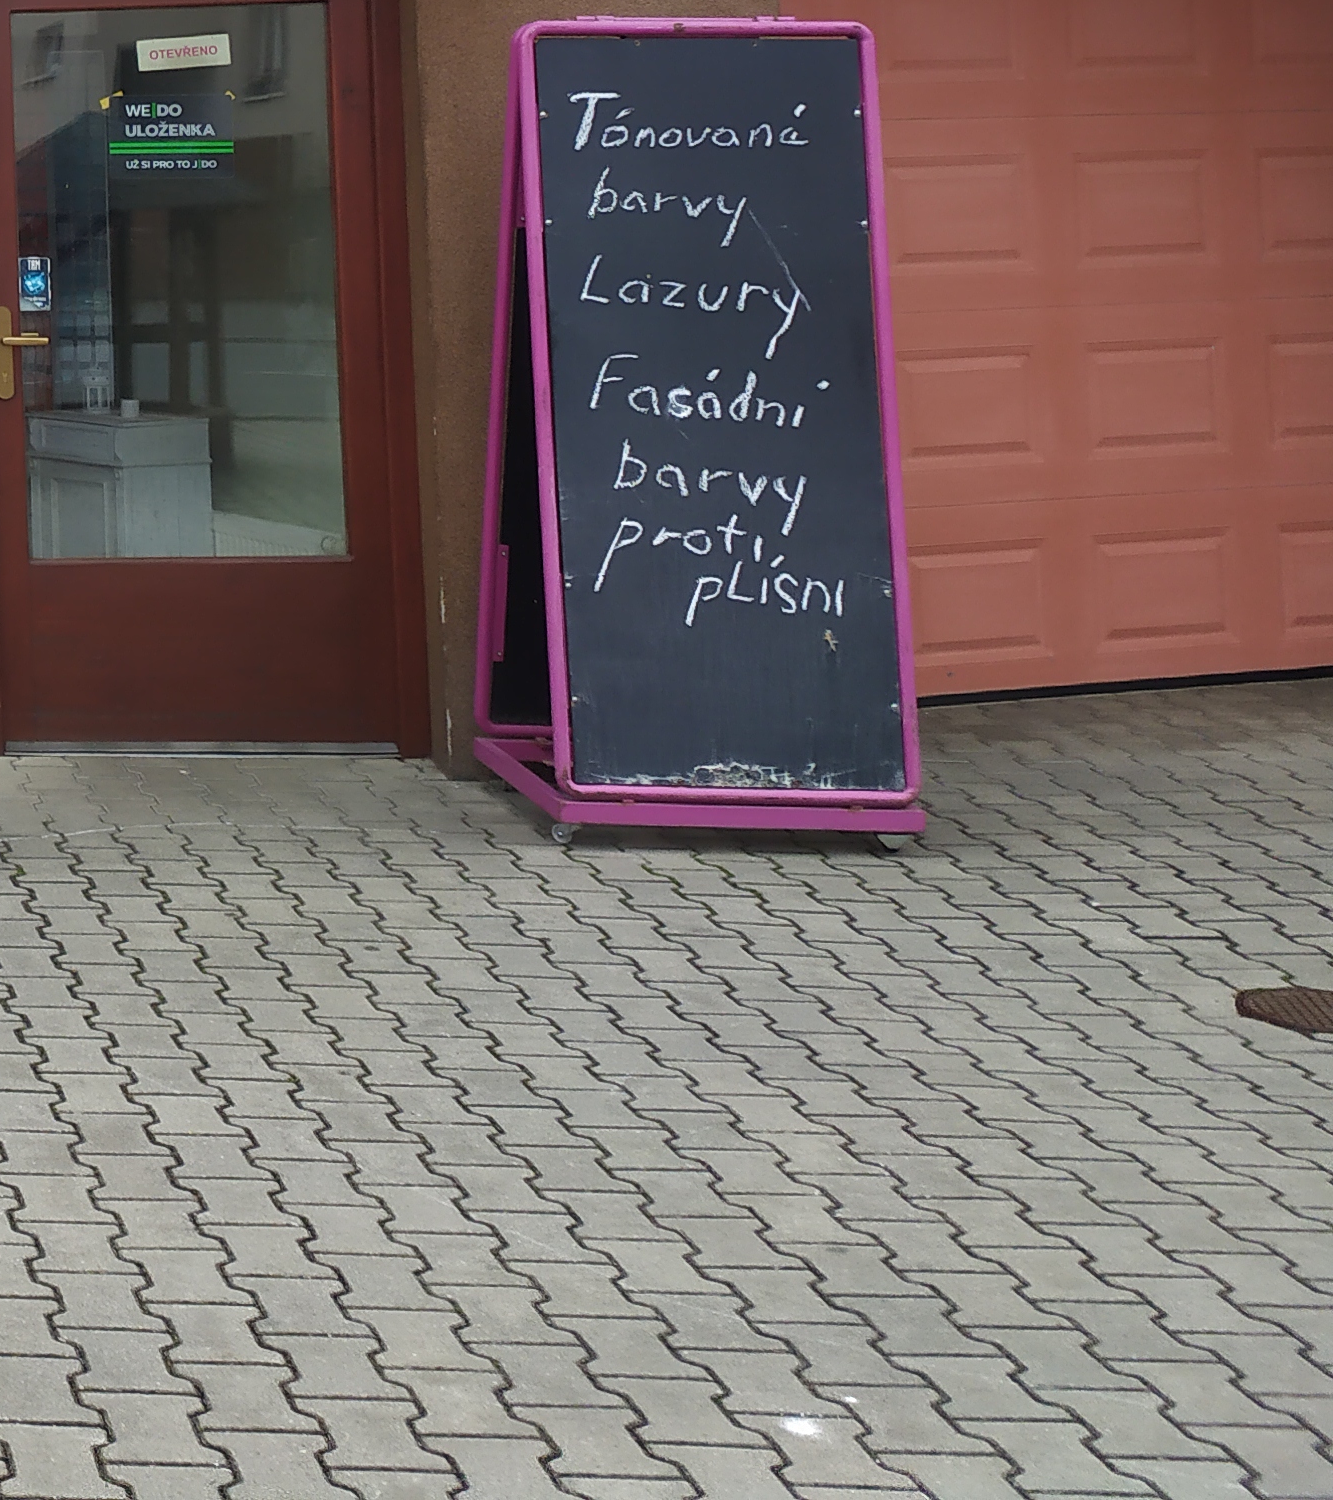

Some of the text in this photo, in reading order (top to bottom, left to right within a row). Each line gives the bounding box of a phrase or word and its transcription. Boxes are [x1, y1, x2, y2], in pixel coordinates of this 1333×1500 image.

[149, 45, 218, 60] OTEVŘENO
[125, 121, 215, 137] ULOŽENKA
[567, 92, 809, 151] Tónované
[126, 158, 139, 169] UŽ
[141, 160, 151, 169] SI
[153, 160, 174, 169] PRO
[176, 160, 190, 168] TO
[587, 166, 747, 247] barvy
[580, 254, 801, 360] Lazury
[614, 438, 807, 536] barvy
[594, 514, 762, 592] proti
